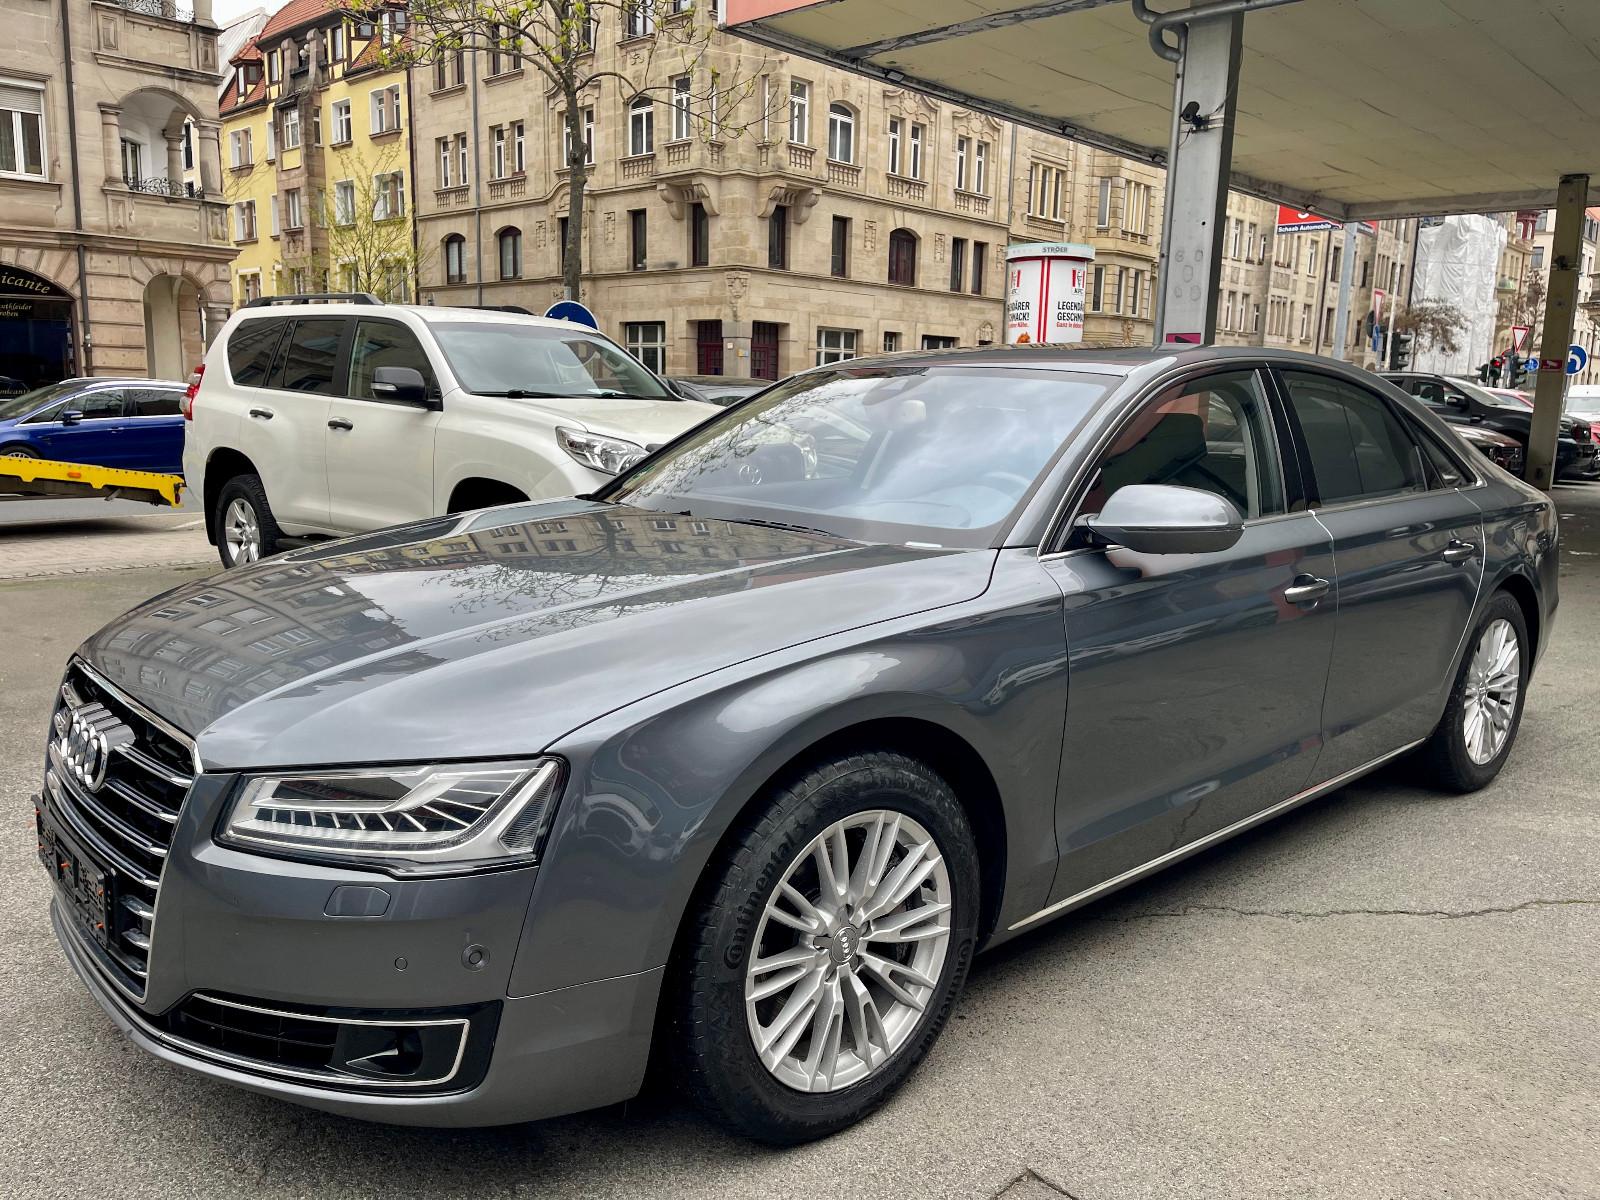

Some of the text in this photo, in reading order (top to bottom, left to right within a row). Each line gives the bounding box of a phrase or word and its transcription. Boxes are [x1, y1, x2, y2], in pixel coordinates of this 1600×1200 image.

[1278, 223, 1332, 233] Schaab Automobile
[723, 838, 798, 970] Continental
